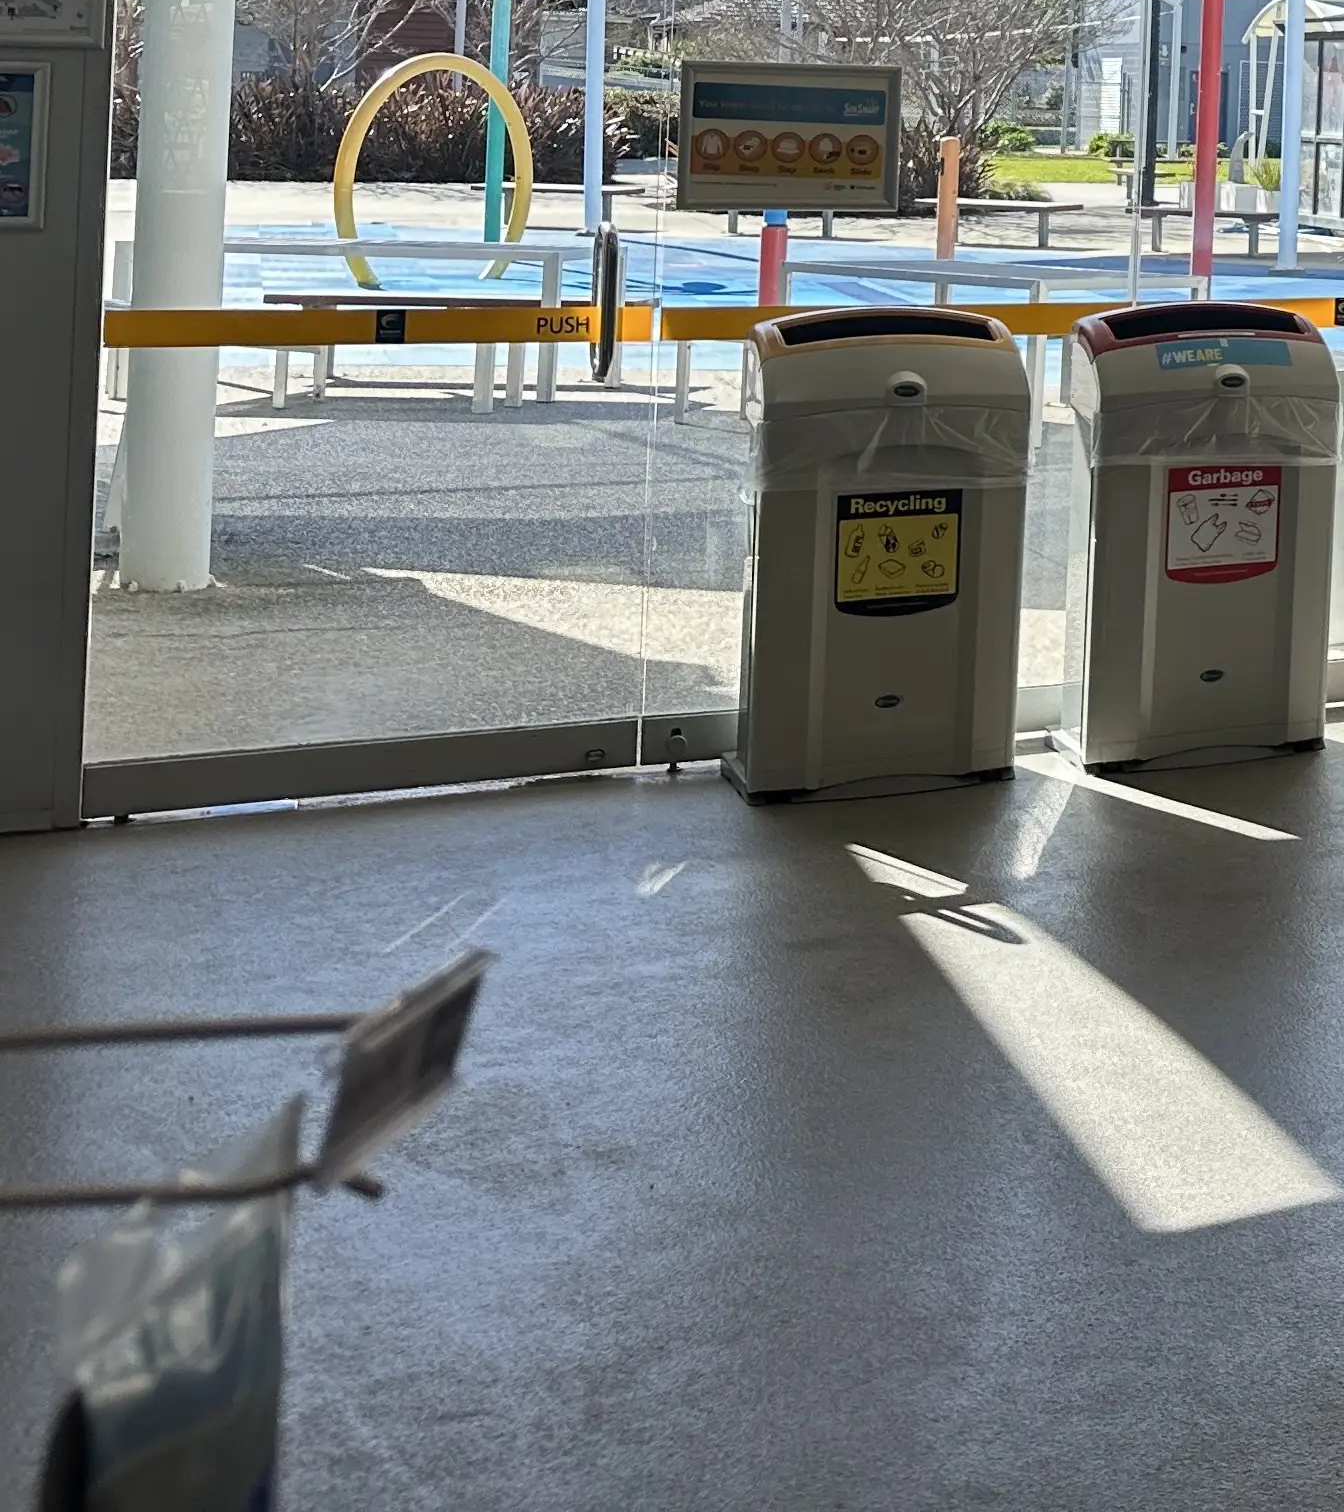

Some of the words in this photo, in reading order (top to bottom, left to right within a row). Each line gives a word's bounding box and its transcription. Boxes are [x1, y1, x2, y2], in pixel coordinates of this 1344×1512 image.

[536, 315, 590, 336] PUSH
[1188, 468, 1264, 486] Garbage
[850, 494, 947, 516] Recycling
